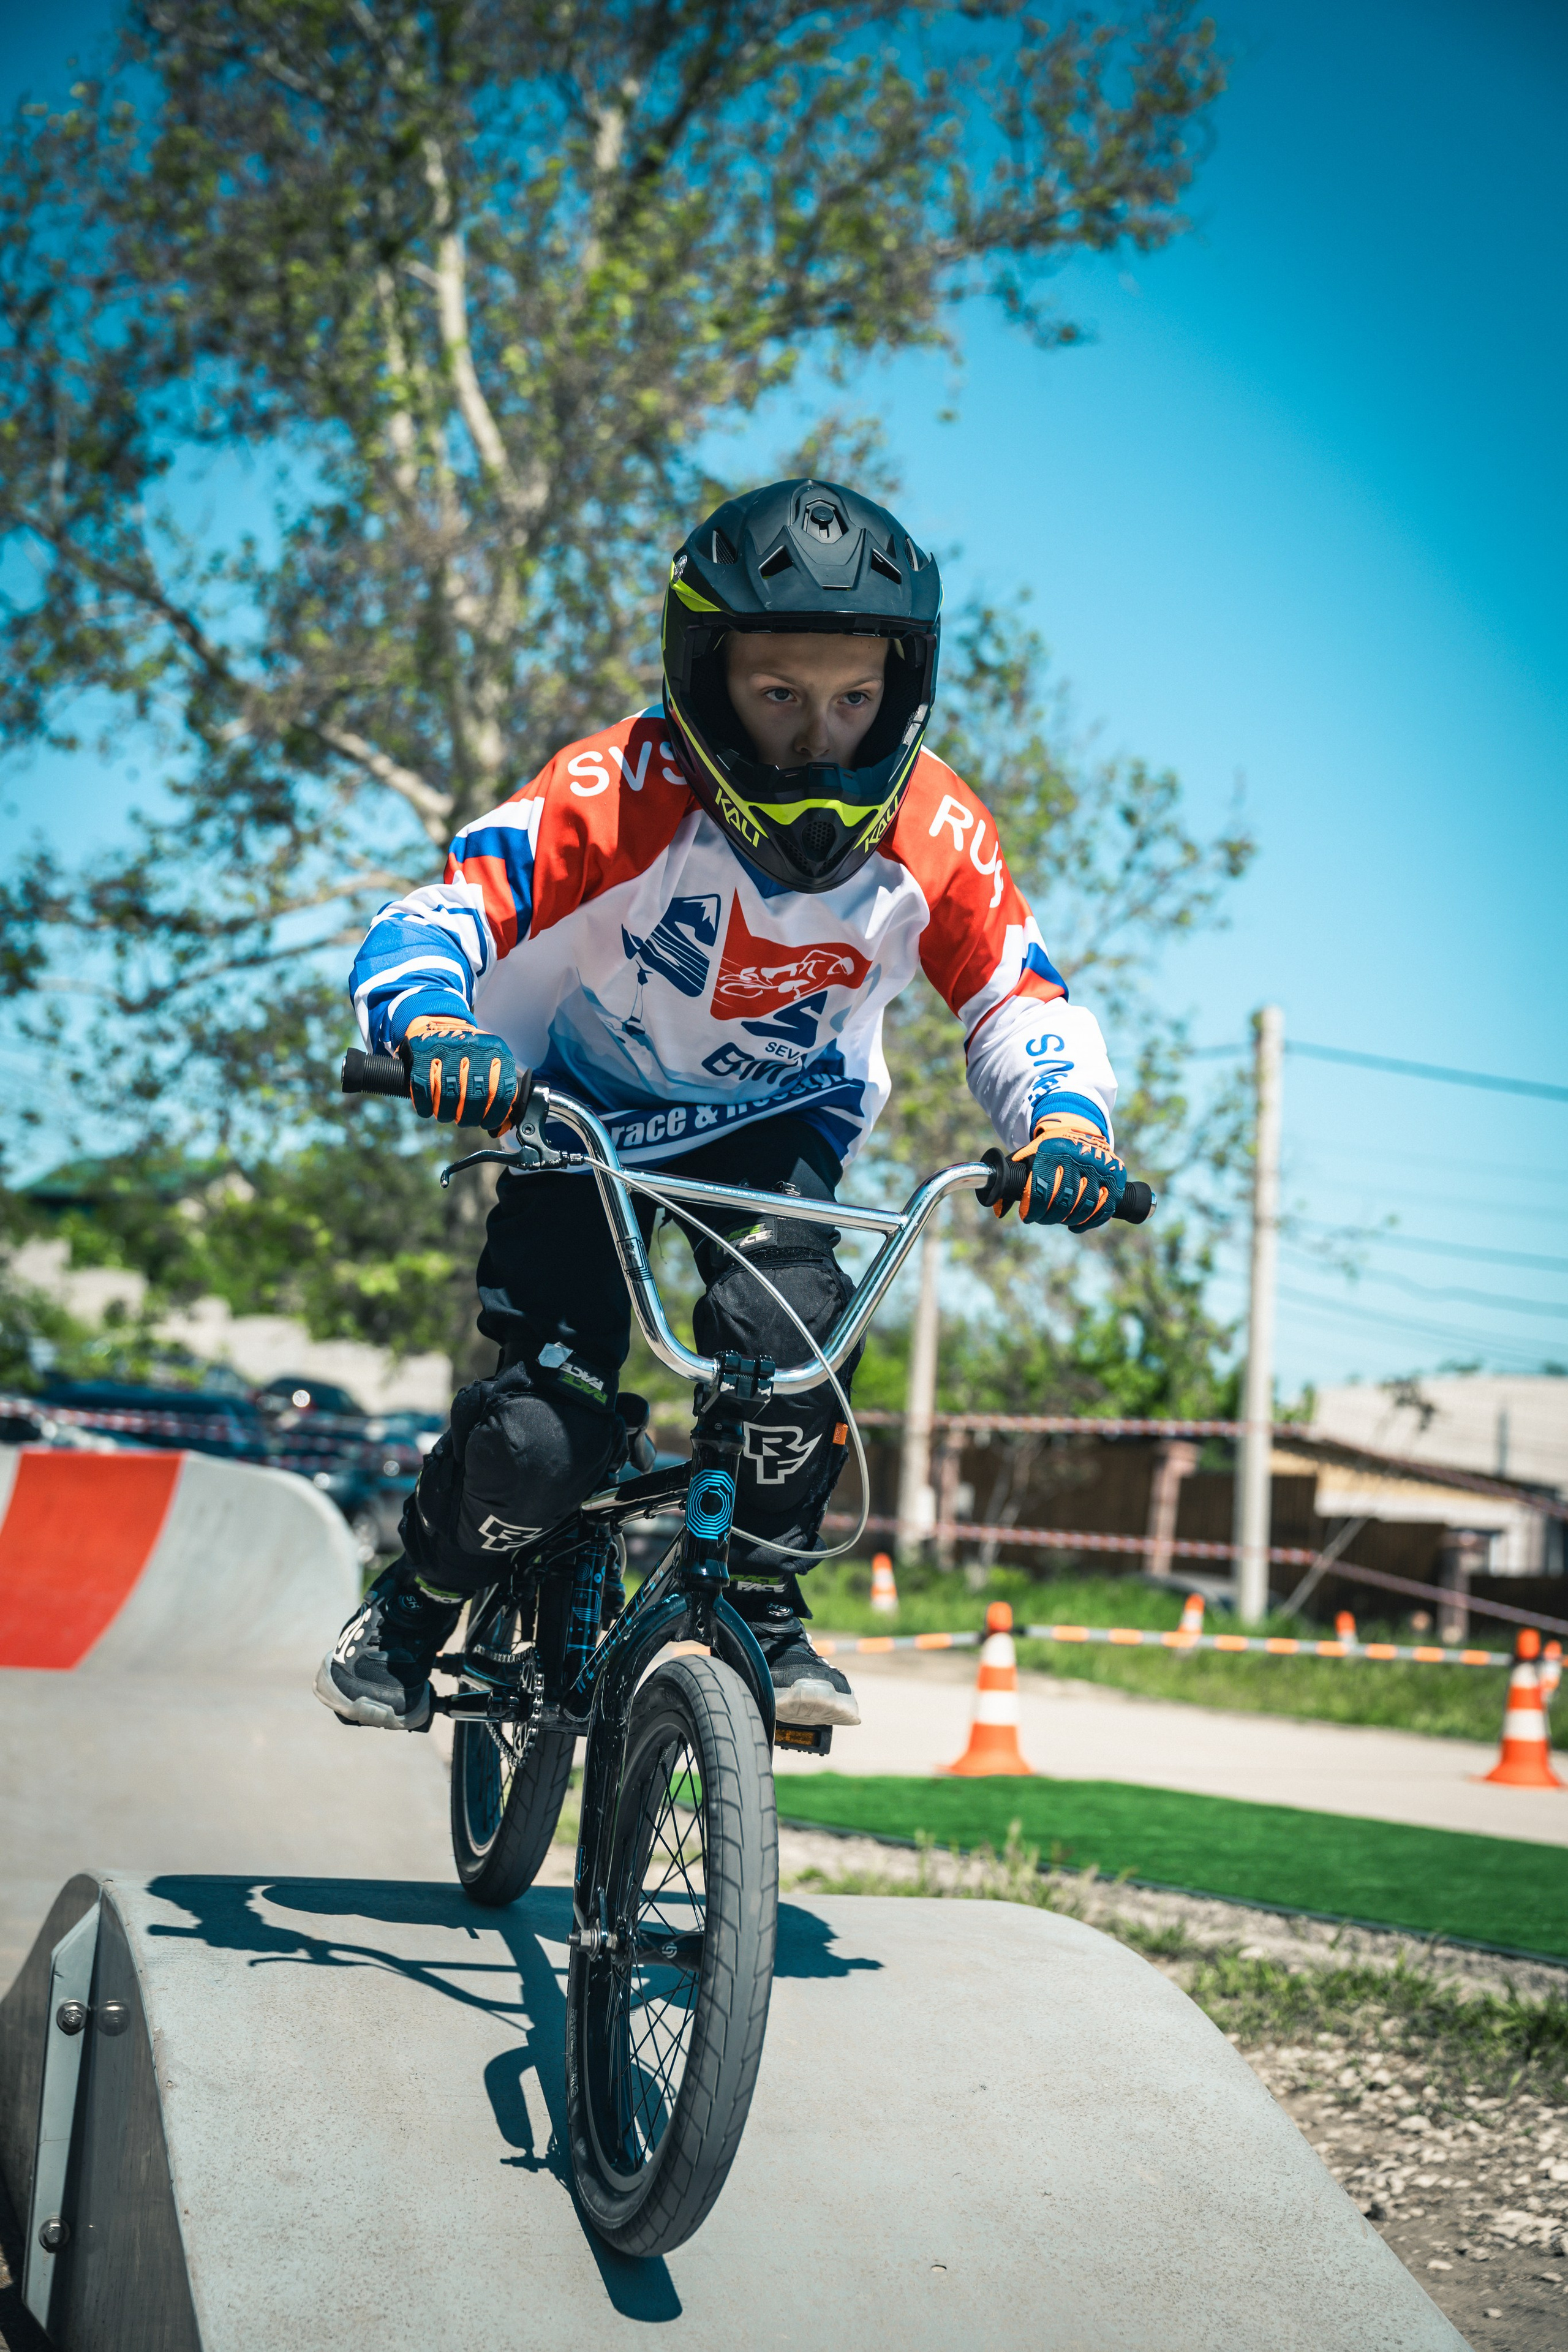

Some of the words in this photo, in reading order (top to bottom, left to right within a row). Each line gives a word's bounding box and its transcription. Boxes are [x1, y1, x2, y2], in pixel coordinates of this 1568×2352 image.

[715, 788, 760, 848] KALI
[765, 1042, 801, 1060] SEV
[611, 1107, 687, 1147] race
[559, 1361, 604, 1391] FACE
[562, 1373, 608, 1404] RACE
[737, 1581, 786, 1593] FACE
